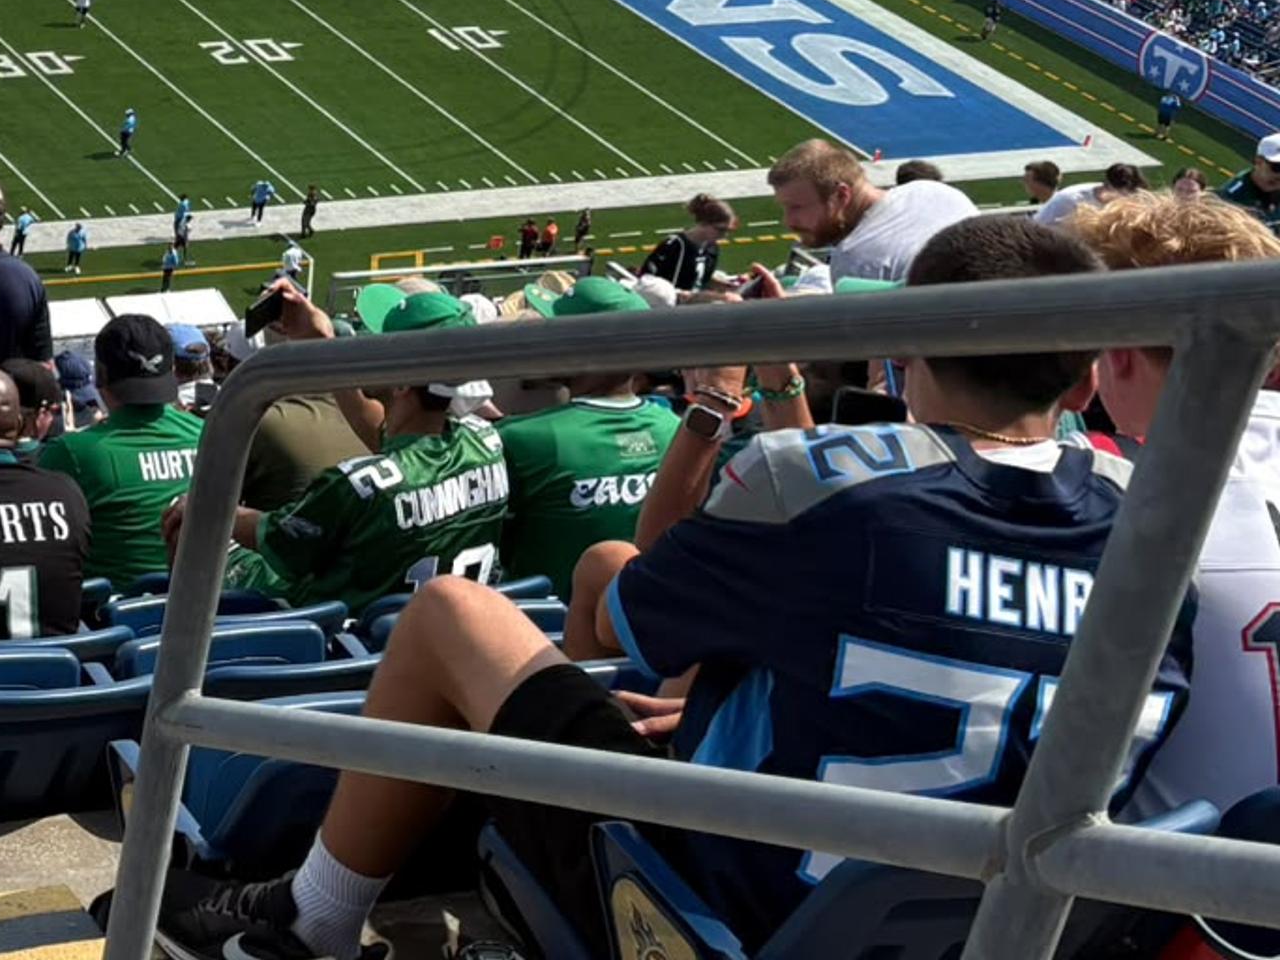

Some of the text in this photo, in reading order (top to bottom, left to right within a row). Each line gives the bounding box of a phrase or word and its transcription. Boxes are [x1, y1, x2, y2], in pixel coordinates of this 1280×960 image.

[199, 38, 296, 66] 20
[426, 24, 503, 50] 10
[138, 448, 198, 481] HURT
[570, 472, 655, 508] EAG
[945, 545, 1096, 636] HENR
